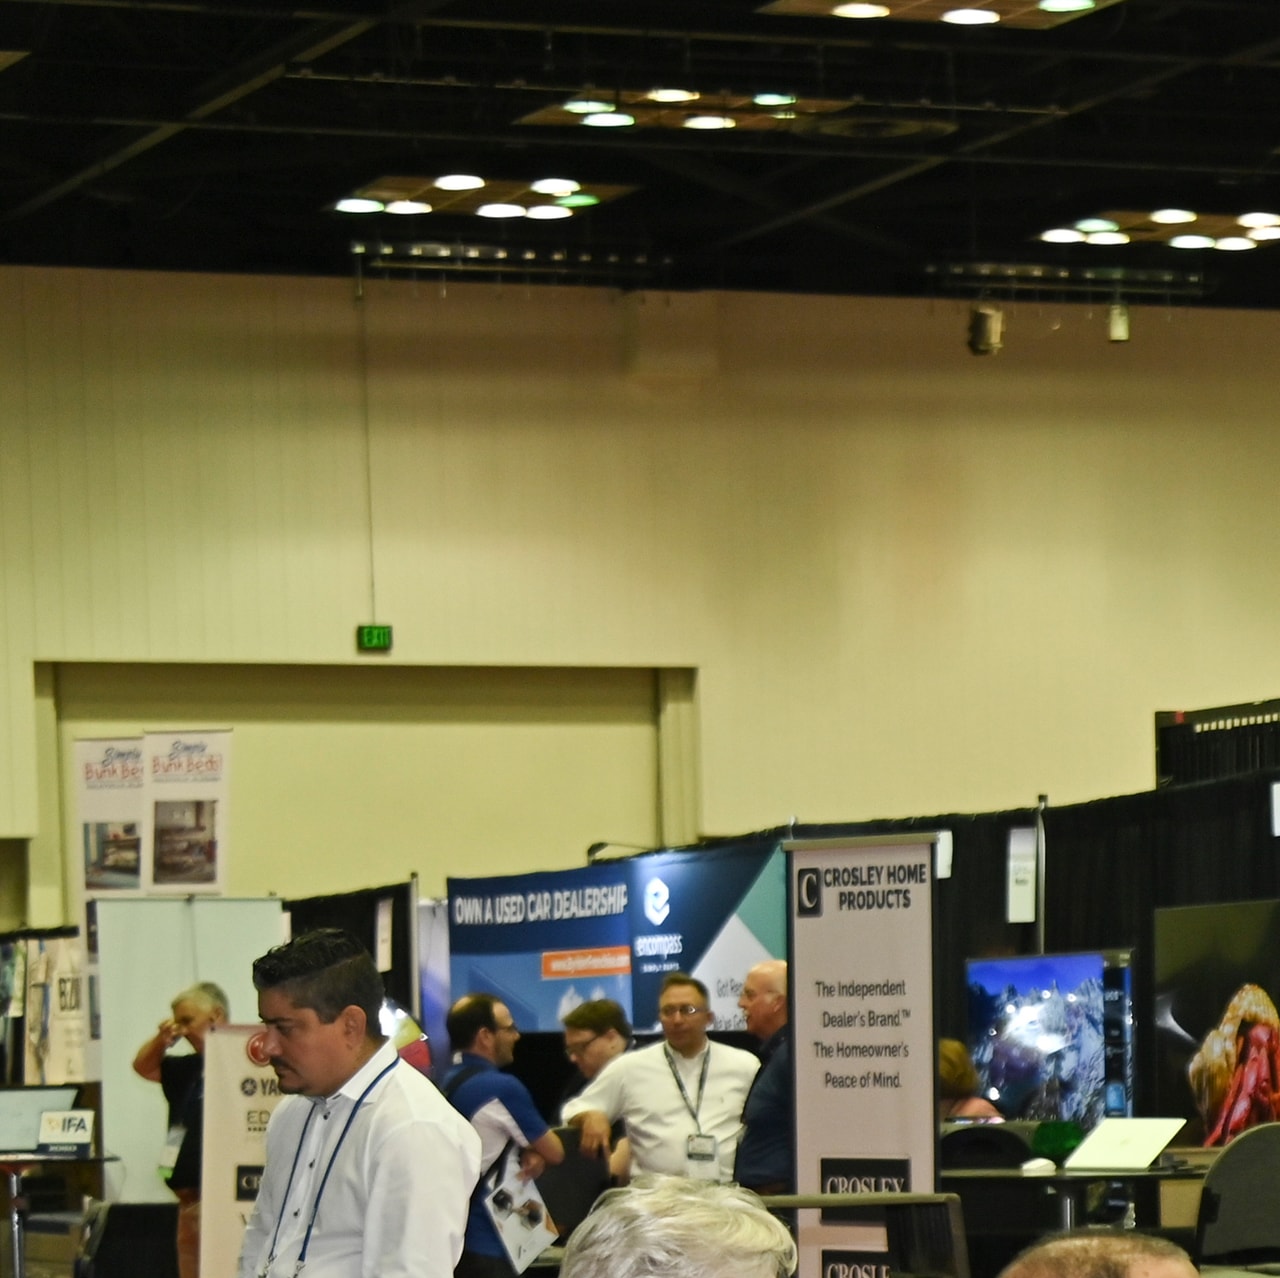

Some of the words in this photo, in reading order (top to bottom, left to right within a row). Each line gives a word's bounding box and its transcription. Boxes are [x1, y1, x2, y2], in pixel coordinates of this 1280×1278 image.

[823, 866, 884, 887] CROSLEY
[887, 863, 927, 884] HOME
[455, 896, 483, 925] OWN
[485, 896, 495, 924] A
[496, 893, 526, 924] USED
[527, 890, 551, 922] CAR
[838, 889, 911, 911] PRODUCTS
[634, 934, 683, 960] encompass
[815, 980, 836, 998] The
[838, 979, 906, 1000] Independent
[822, 1010, 866, 1028] Dealer's
[813, 1041, 835, 1058] The
[836, 1041, 910, 1058] Homeowner's
[824, 1071, 858, 1089] Peace
[860, 1070, 872, 1089] of
[873, 1071, 902, 1088] Mind.
[62, 1117, 87, 1133] IFA
